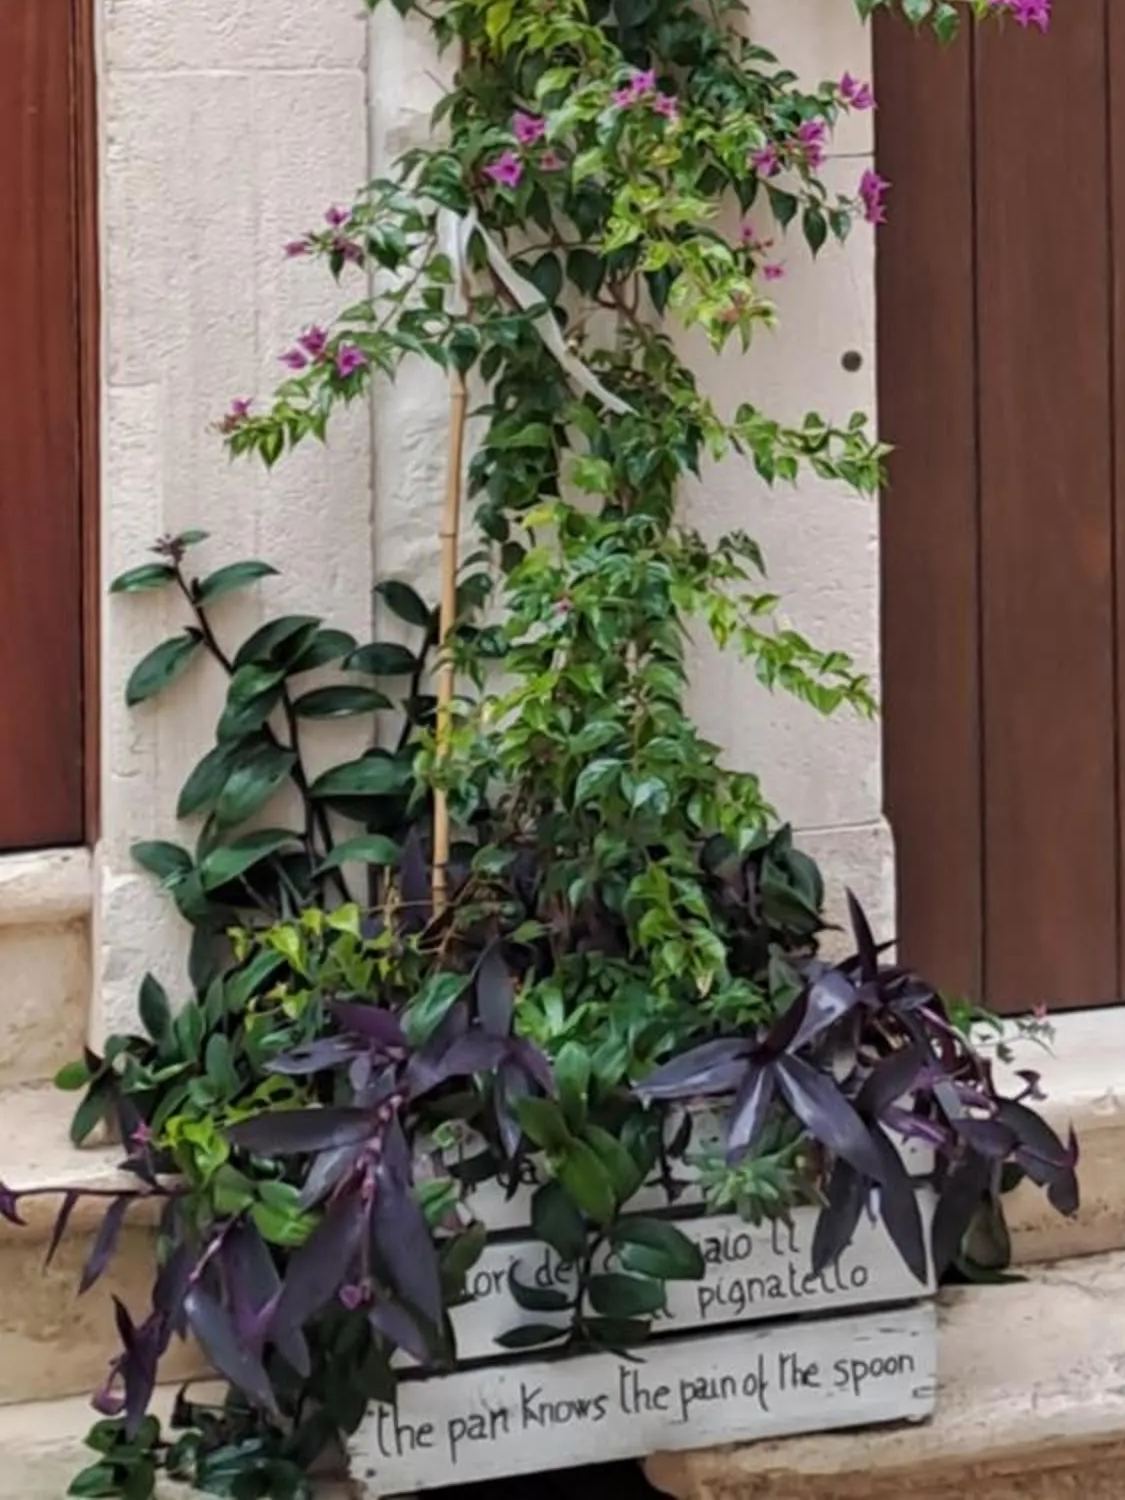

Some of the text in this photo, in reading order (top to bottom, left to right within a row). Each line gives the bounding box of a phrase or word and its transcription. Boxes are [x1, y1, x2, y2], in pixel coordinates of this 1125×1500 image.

[447, 1407, 509, 1465] pan
[618, 1365, 671, 1414] the
[679, 1376, 737, 1423] pain
[742, 1353, 769, 1412] of
[833, 1353, 915, 1397] spoon
